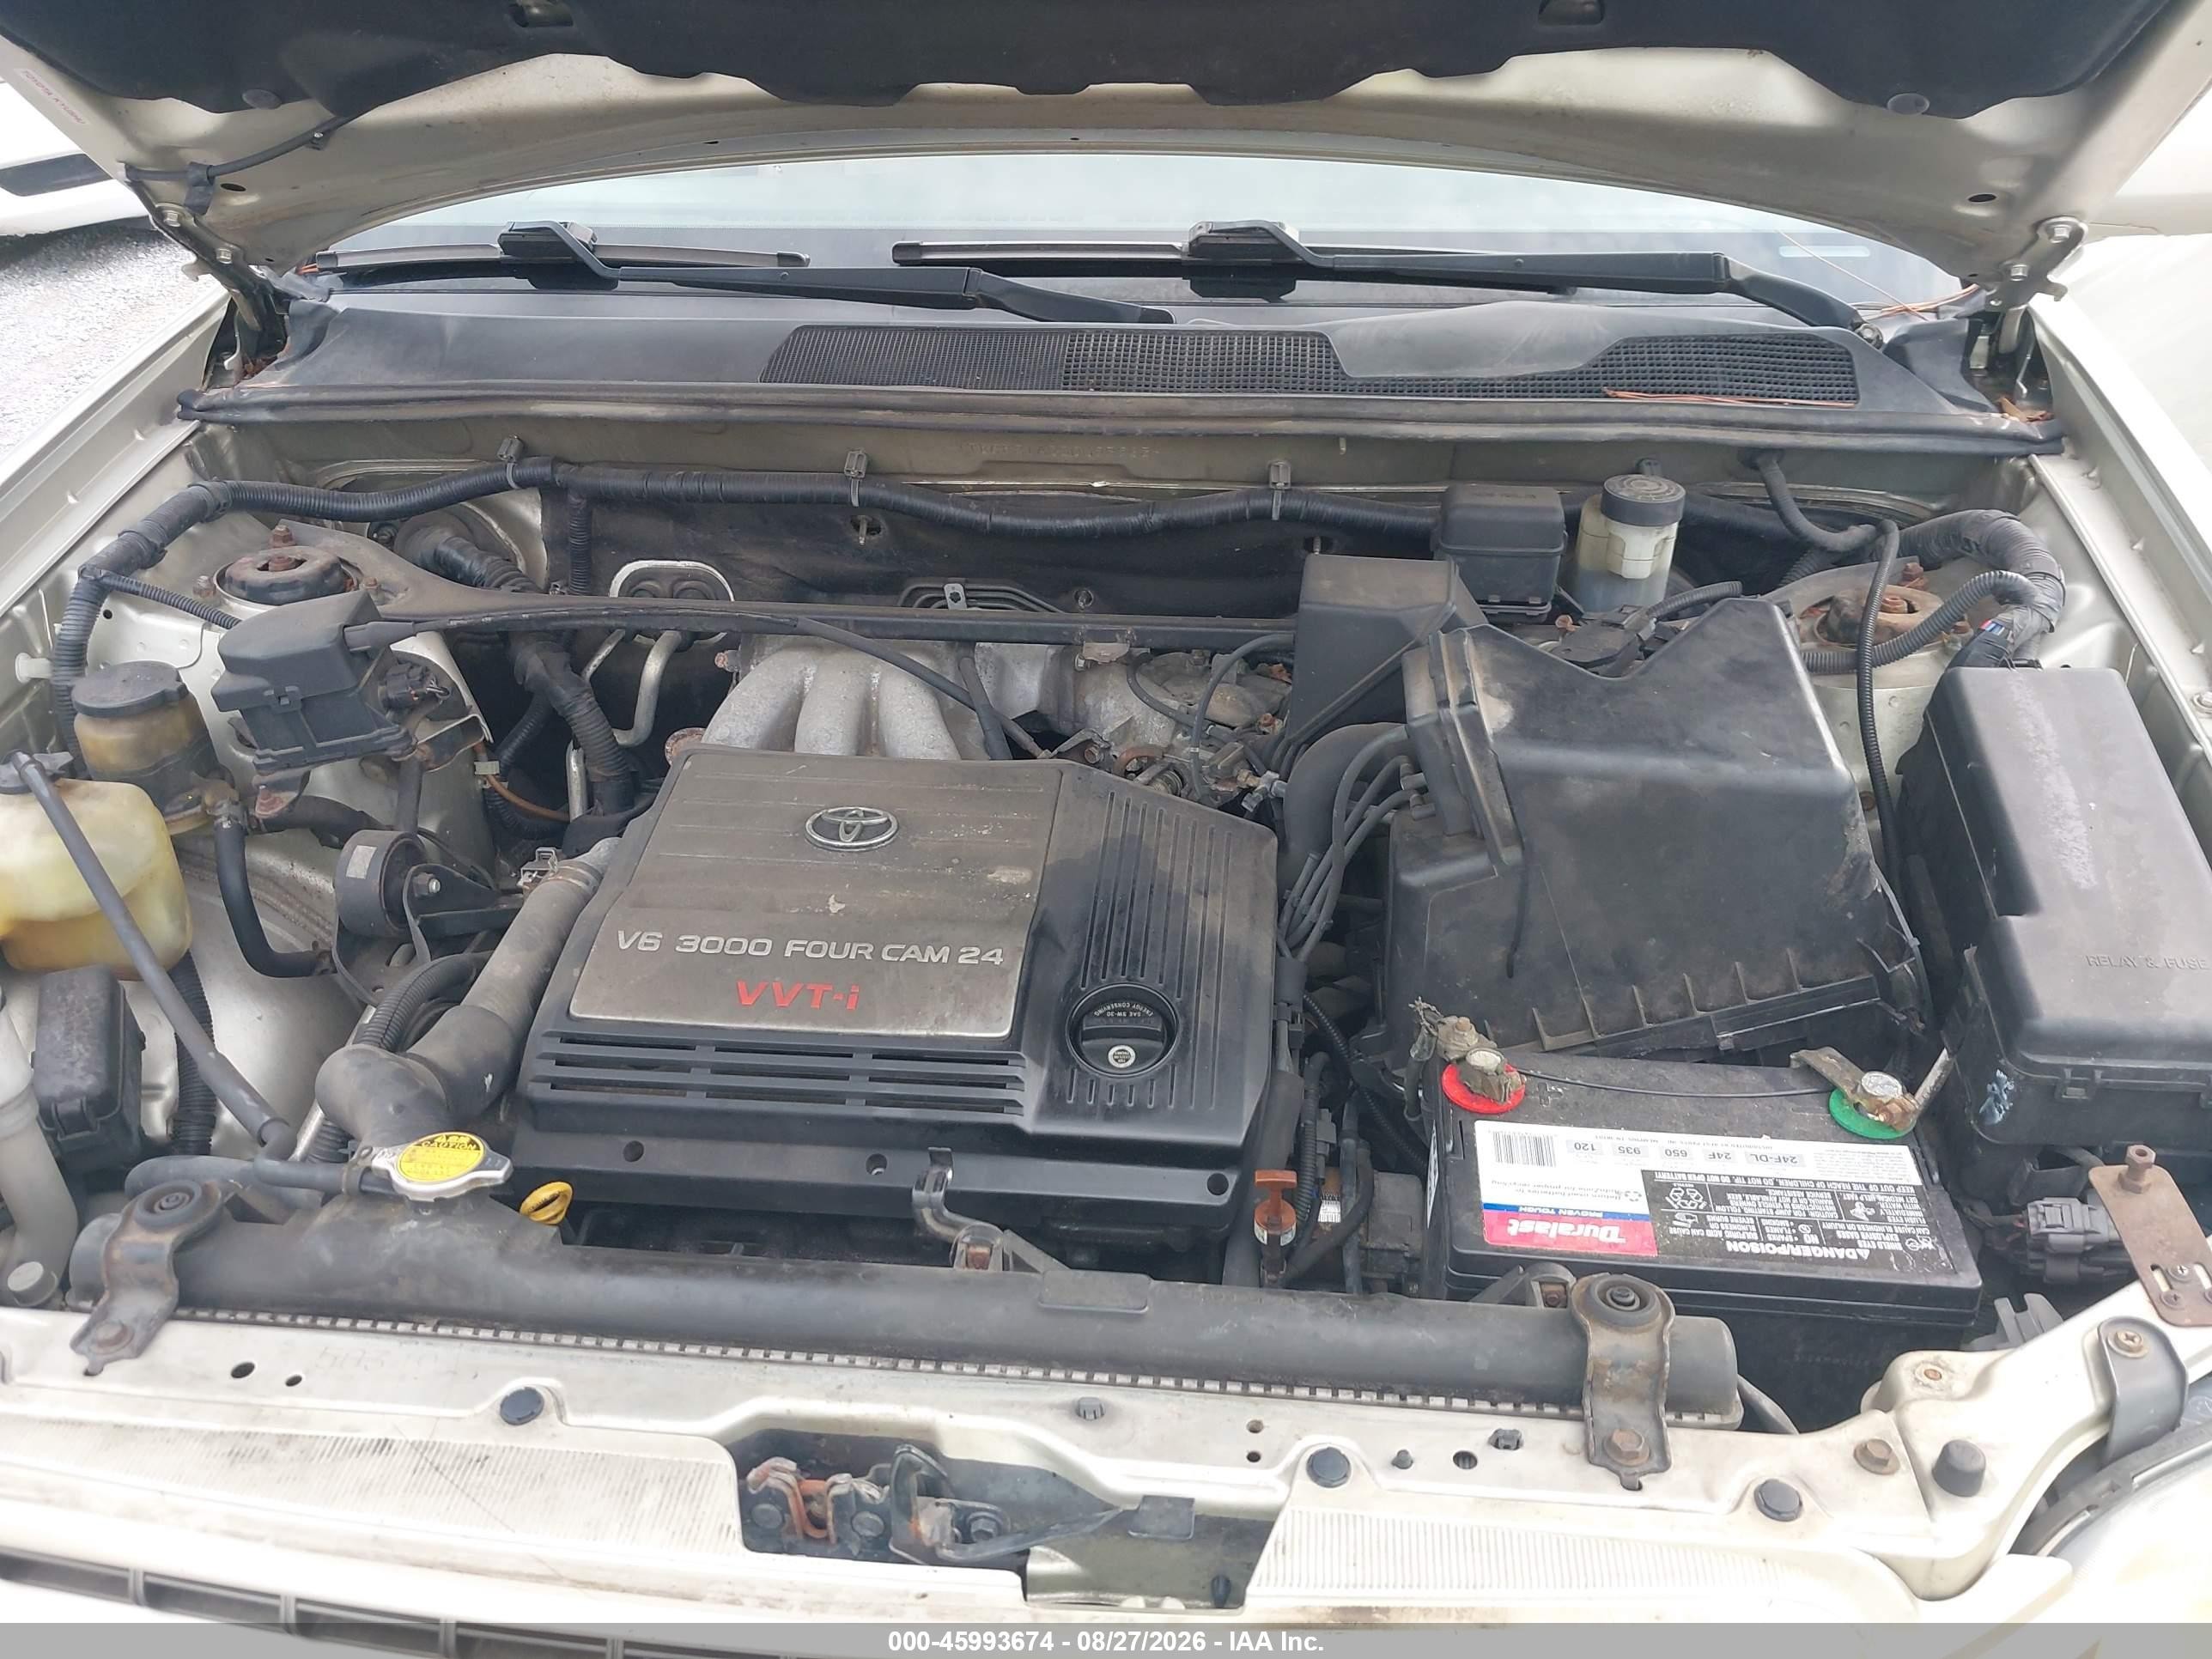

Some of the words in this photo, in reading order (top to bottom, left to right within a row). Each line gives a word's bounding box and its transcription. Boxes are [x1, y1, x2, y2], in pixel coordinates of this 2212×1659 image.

[617, 930, 663, 951] V6
[675, 934, 773, 956] 3000
[784, 939, 874, 959] FOUR
[881, 944, 951, 963] CAM
[957, 947, 1004, 965] 24
[2086, 955, 2136, 968] RELAY
[2145, 957, 2158, 969] &
[2164, 957, 2208, 969] FUSE
[422, 1140, 477, 1150] CAUTION
[1574, 1142, 1596, 1152] 120
[1618, 1146, 1641, 1155] 935
[1665, 1148, 1687, 1158] 650
[1708, 1152, 1731, 1160] 24F
[1750, 1153, 1798, 1164] 24F-DL
[1518, 1206, 1556, 1216] TOUGH
[1558, 1208, 1603, 1218] PROVEN
[1507, 1218, 1626, 1243] Duralast
[1804, 1234, 1819, 1243] NO
